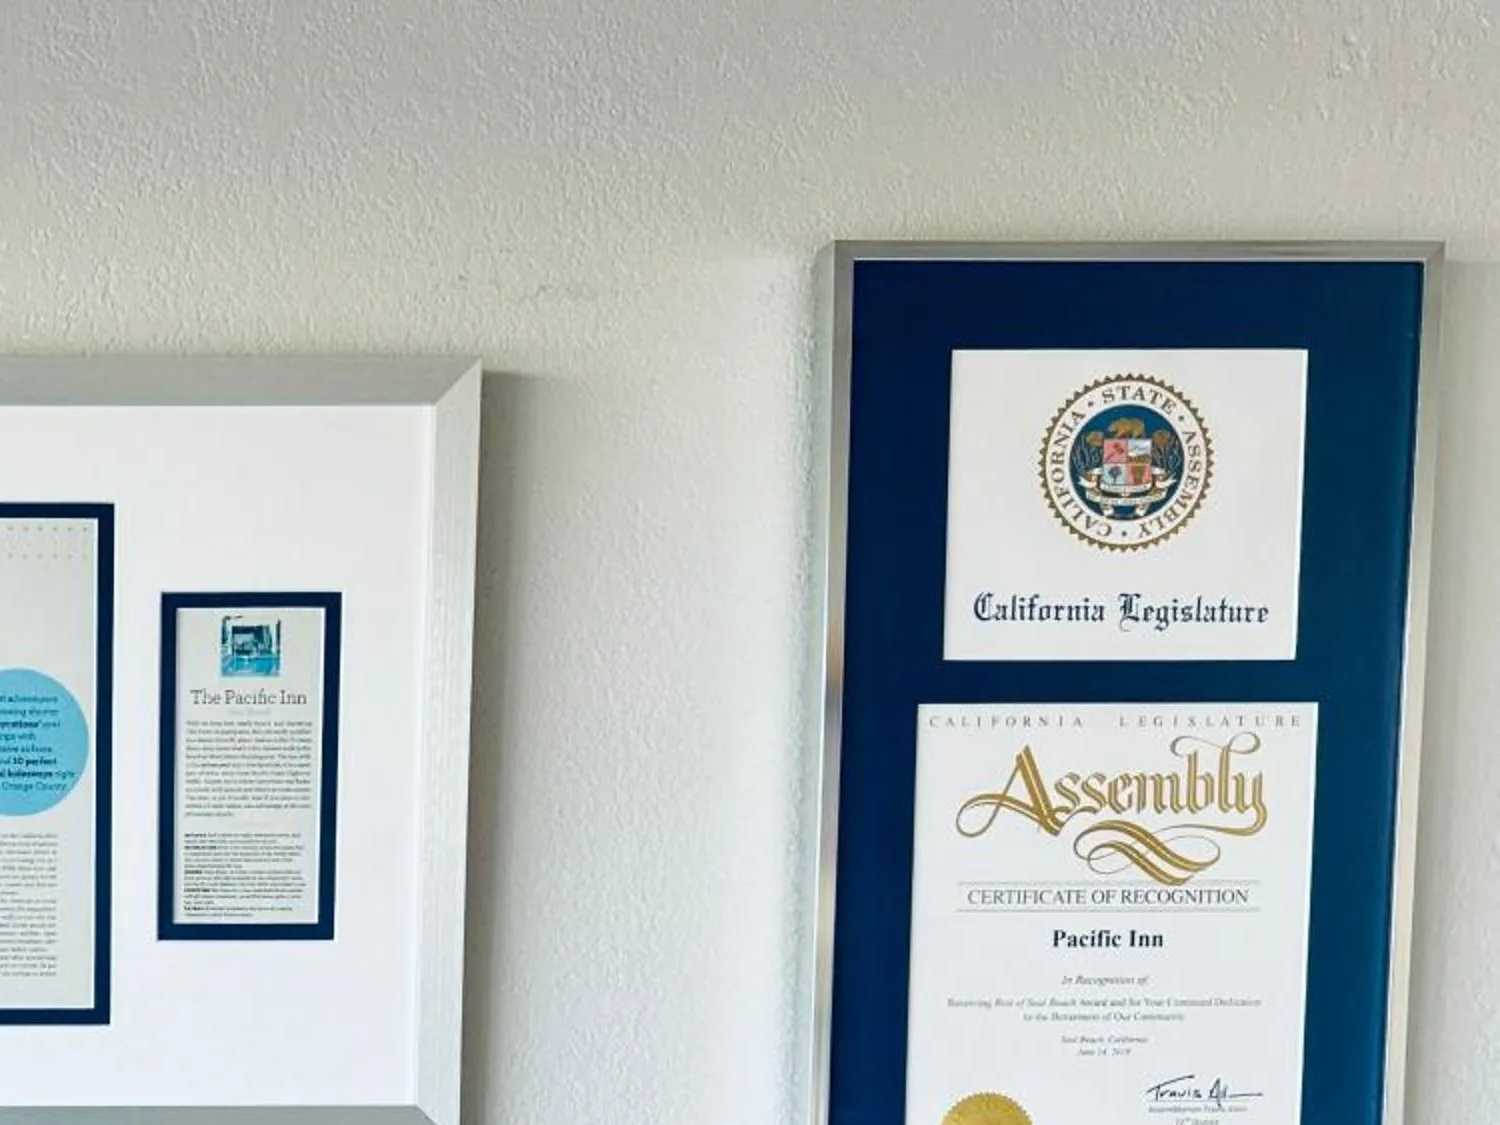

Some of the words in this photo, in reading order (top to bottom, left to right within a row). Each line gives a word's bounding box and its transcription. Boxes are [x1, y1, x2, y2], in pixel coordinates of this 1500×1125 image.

[1102, 385, 1177, 415] STATE
[1051, 411, 1113, 537] CALIFORNIA
[1138, 429, 1200, 537] ASSEMBLY
[973, 592, 1105, 622] California
[1118, 593, 1269, 632] Legislature
[190, 688, 221, 705] The
[225, 688, 276, 705] Pacific
[280, 690, 307, 705] Inn
[930, 715, 1084, 728] CALIFORNIA
[1119, 715, 1301, 728] LEGISLATURE
[956, 732, 1268, 840] Assembly
[968, 889, 1087, 906] CERTIFICATE
[1092, 889, 1116, 906] OF
[1121, 889, 1249, 906] RECOGNITION
[1052, 929, 1122, 949] Pacific
[1129, 930, 1164, 949] Inn
